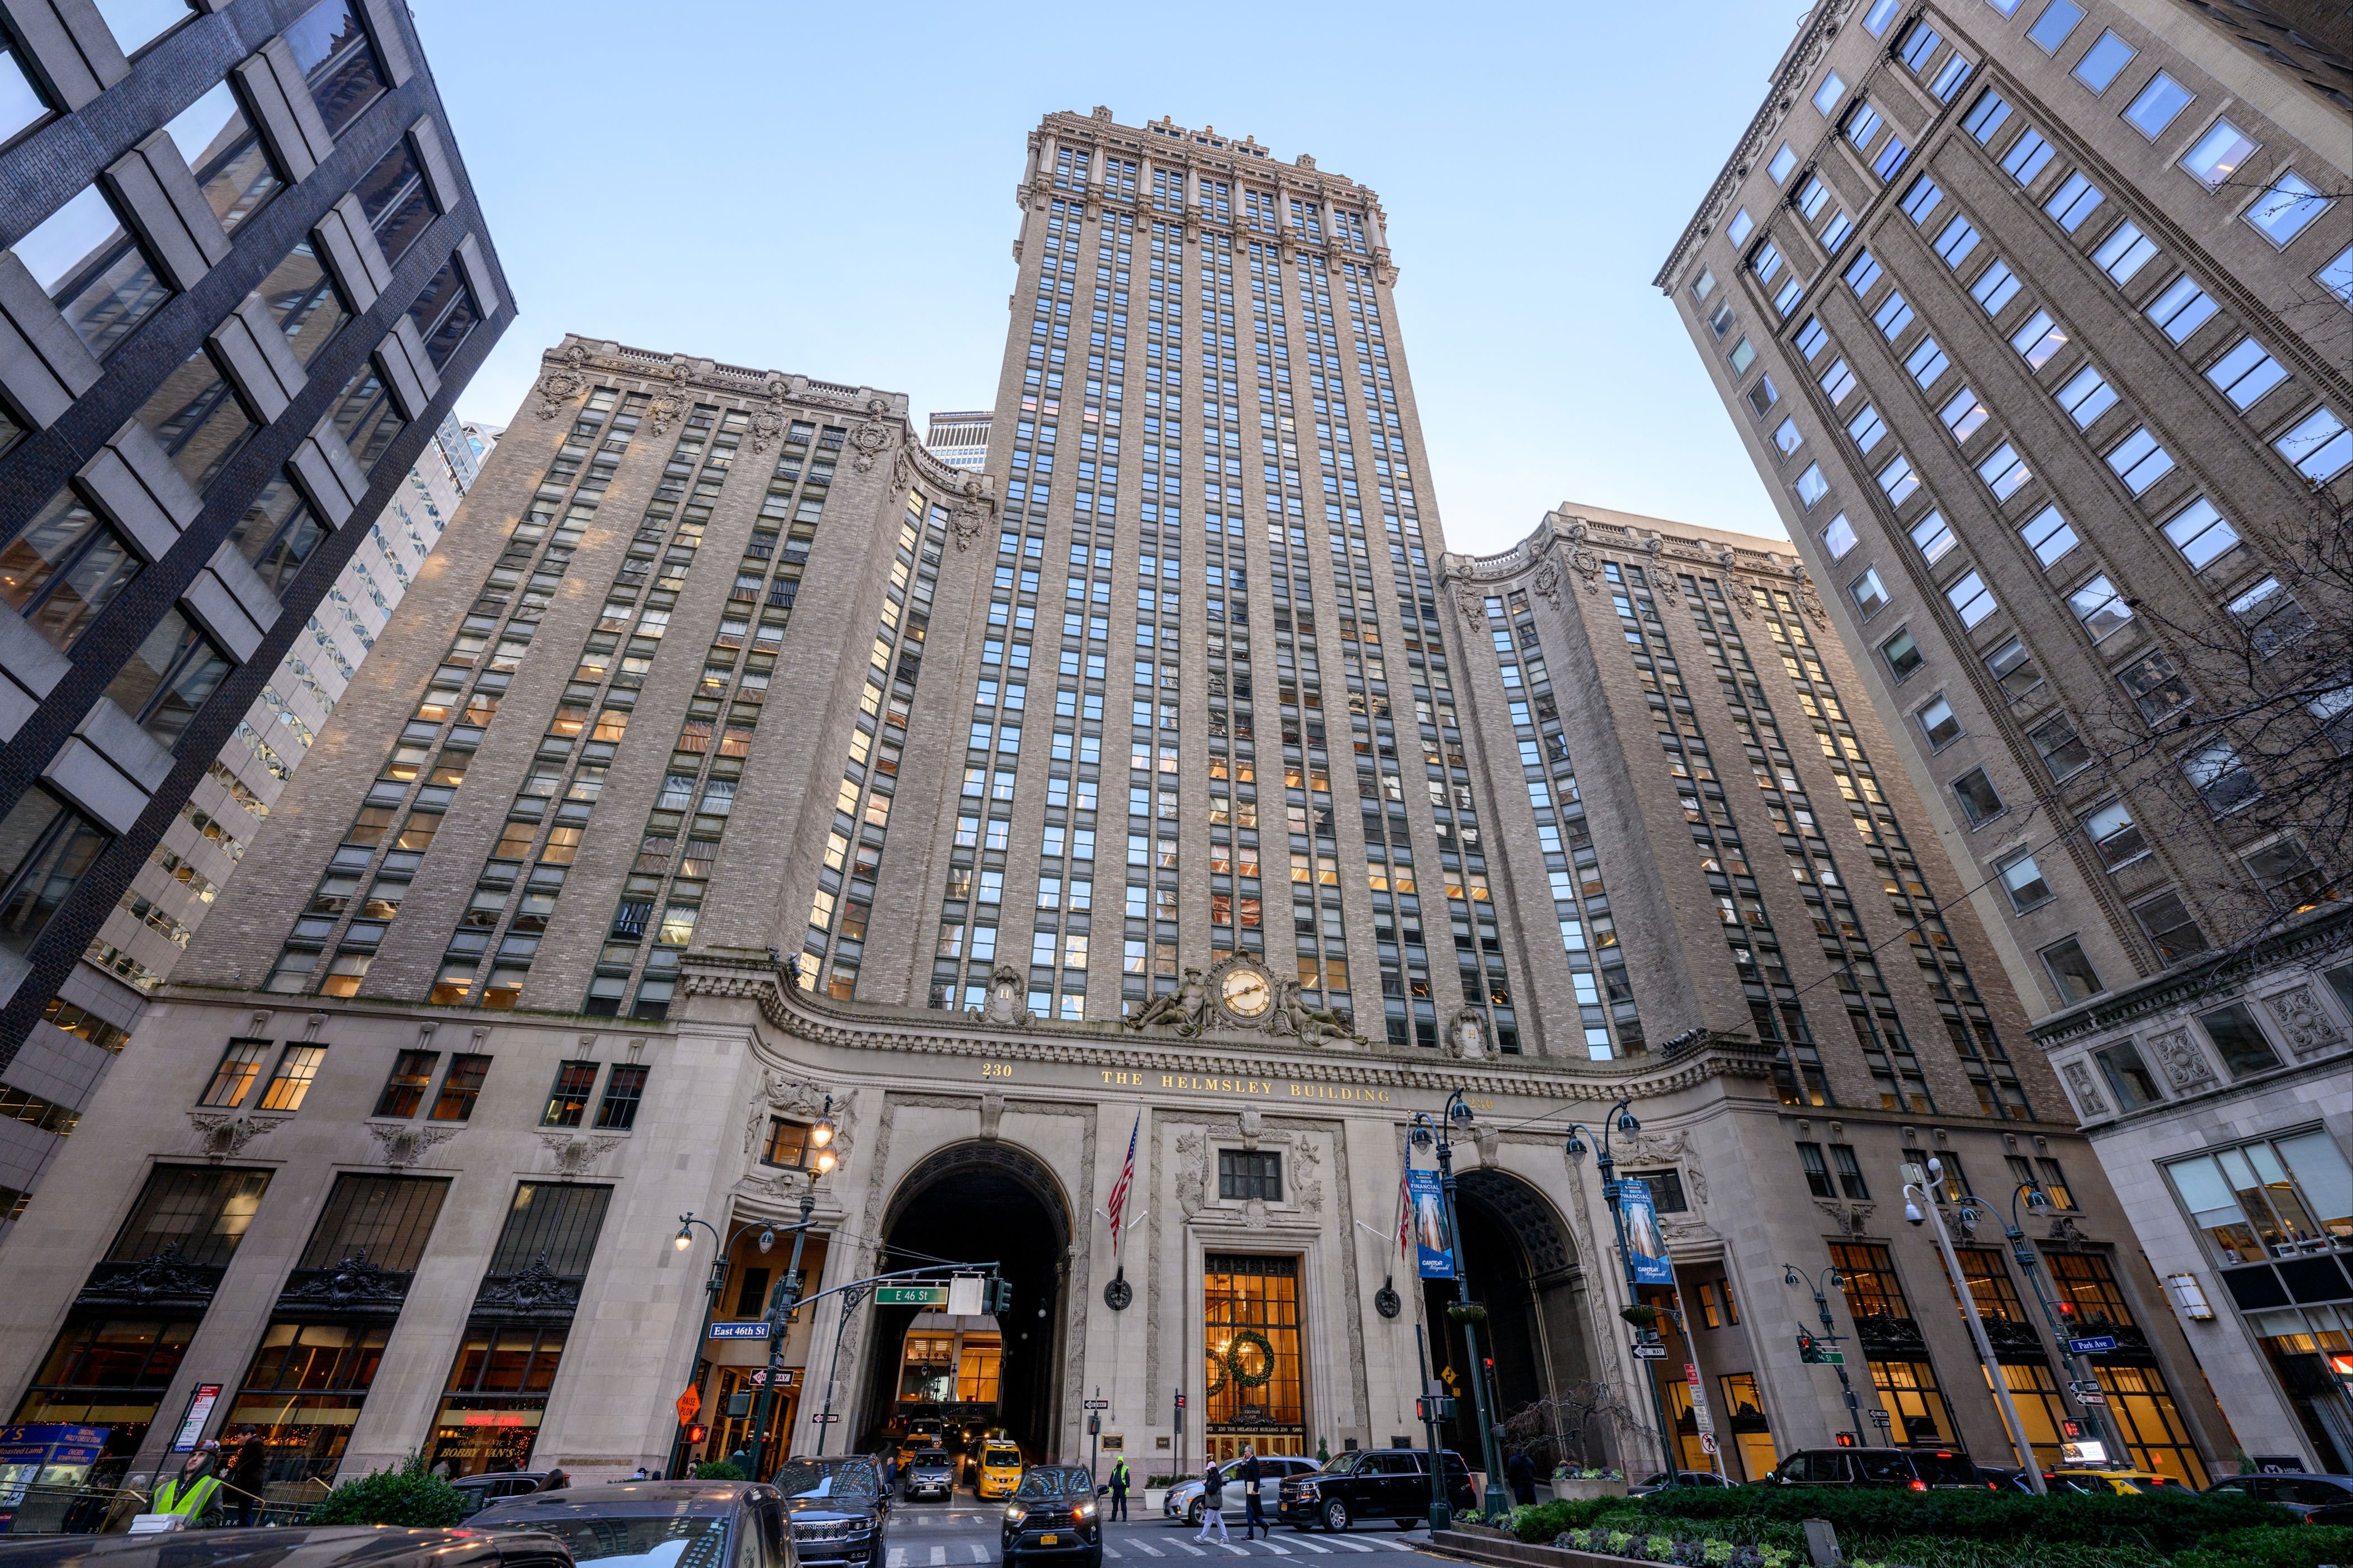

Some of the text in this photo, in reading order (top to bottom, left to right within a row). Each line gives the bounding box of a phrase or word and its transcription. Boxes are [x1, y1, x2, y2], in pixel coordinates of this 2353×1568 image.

[1000, 989, 1009, 999] H
[1467, 1029, 1476, 1038] H
[982, 1063, 1012, 1077] 230
[1102, 1071, 1390, 1102] THE HELMSLEY BUILDING
[1468, 1097, 1494, 1110] 230
[1428, 1264, 1450, 1272] Fitzgerald
[896, 1291, 928, 1300] E 46 St
[714, 1326, 765, 1335] East 46th St
[682, 1397, 696, 1406] RAISE
[679, 1407, 694, 1416] PLOW
[440, 1448, 516, 1458] BOBBY VAN'S
